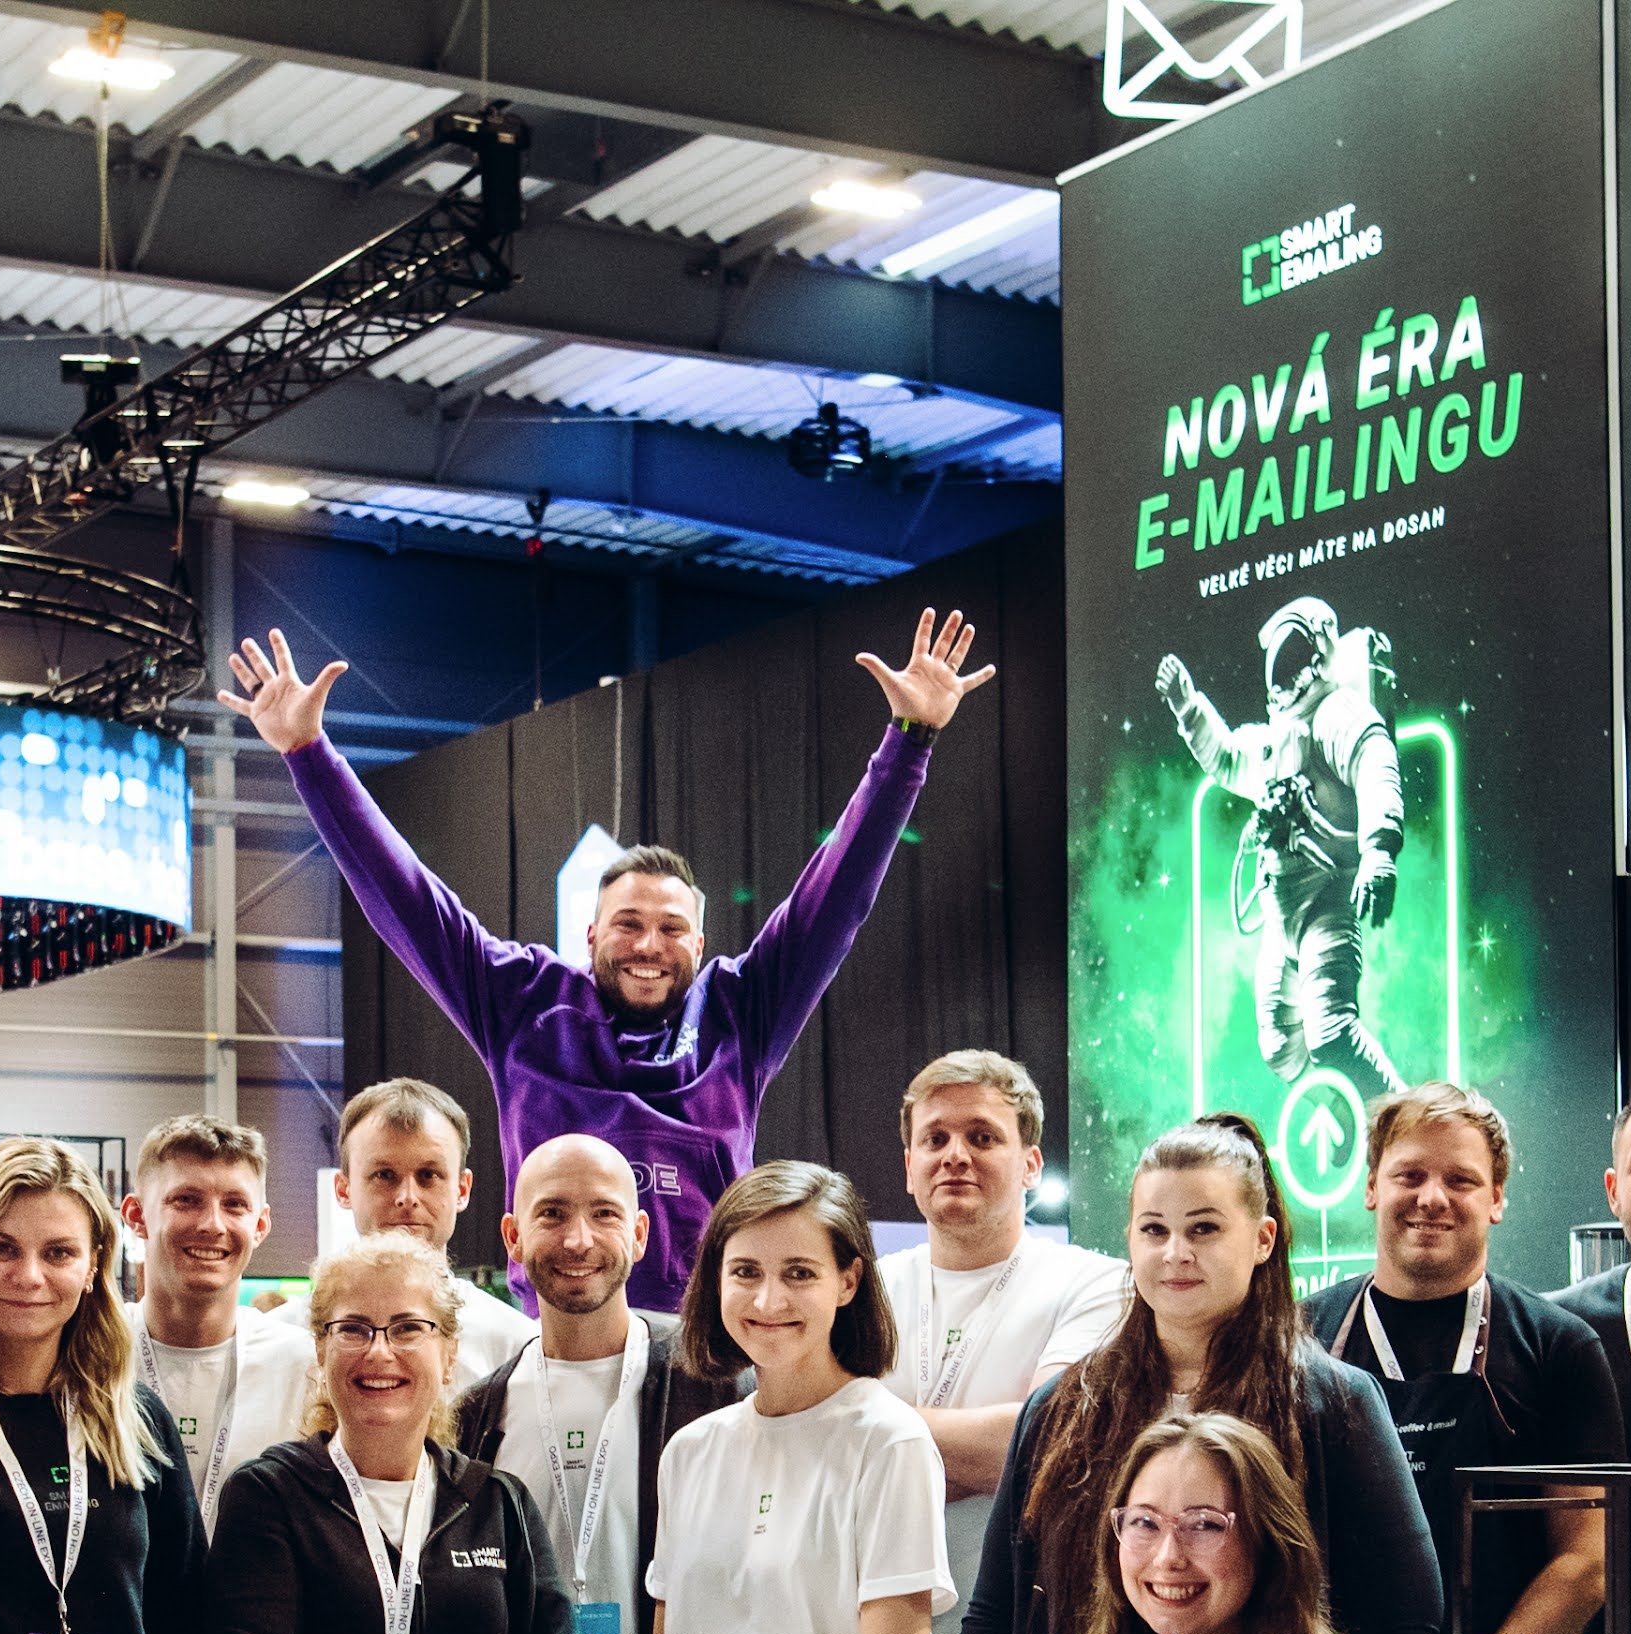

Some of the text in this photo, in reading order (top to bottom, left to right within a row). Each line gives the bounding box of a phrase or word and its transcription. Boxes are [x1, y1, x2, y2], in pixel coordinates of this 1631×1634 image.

[1280, 203, 1355, 259] SMART
[1280, 224, 1383, 291] EMAILING
[1163, 295, 1486, 477] NOVÁ ÉRA
[1134, 372, 1523, 571] E-MAILINGU
[1198, 506, 1446, 598] VELKÉ VĚCI MÁTE NA DOSAH
[73, 1469, 84, 1494] EXPO
[582, 1510, 596, 1546] CZECH
[596, 1438, 609, 1466] EXPO
[12, 1471, 30, 1500] CZECH
[39, 1545, 54, 1575] EXPO
[471, 1547, 501, 1558] SMART
[374, 1553, 390, 1585] CZECH
[403, 1560, 415, 1586] EXPO
